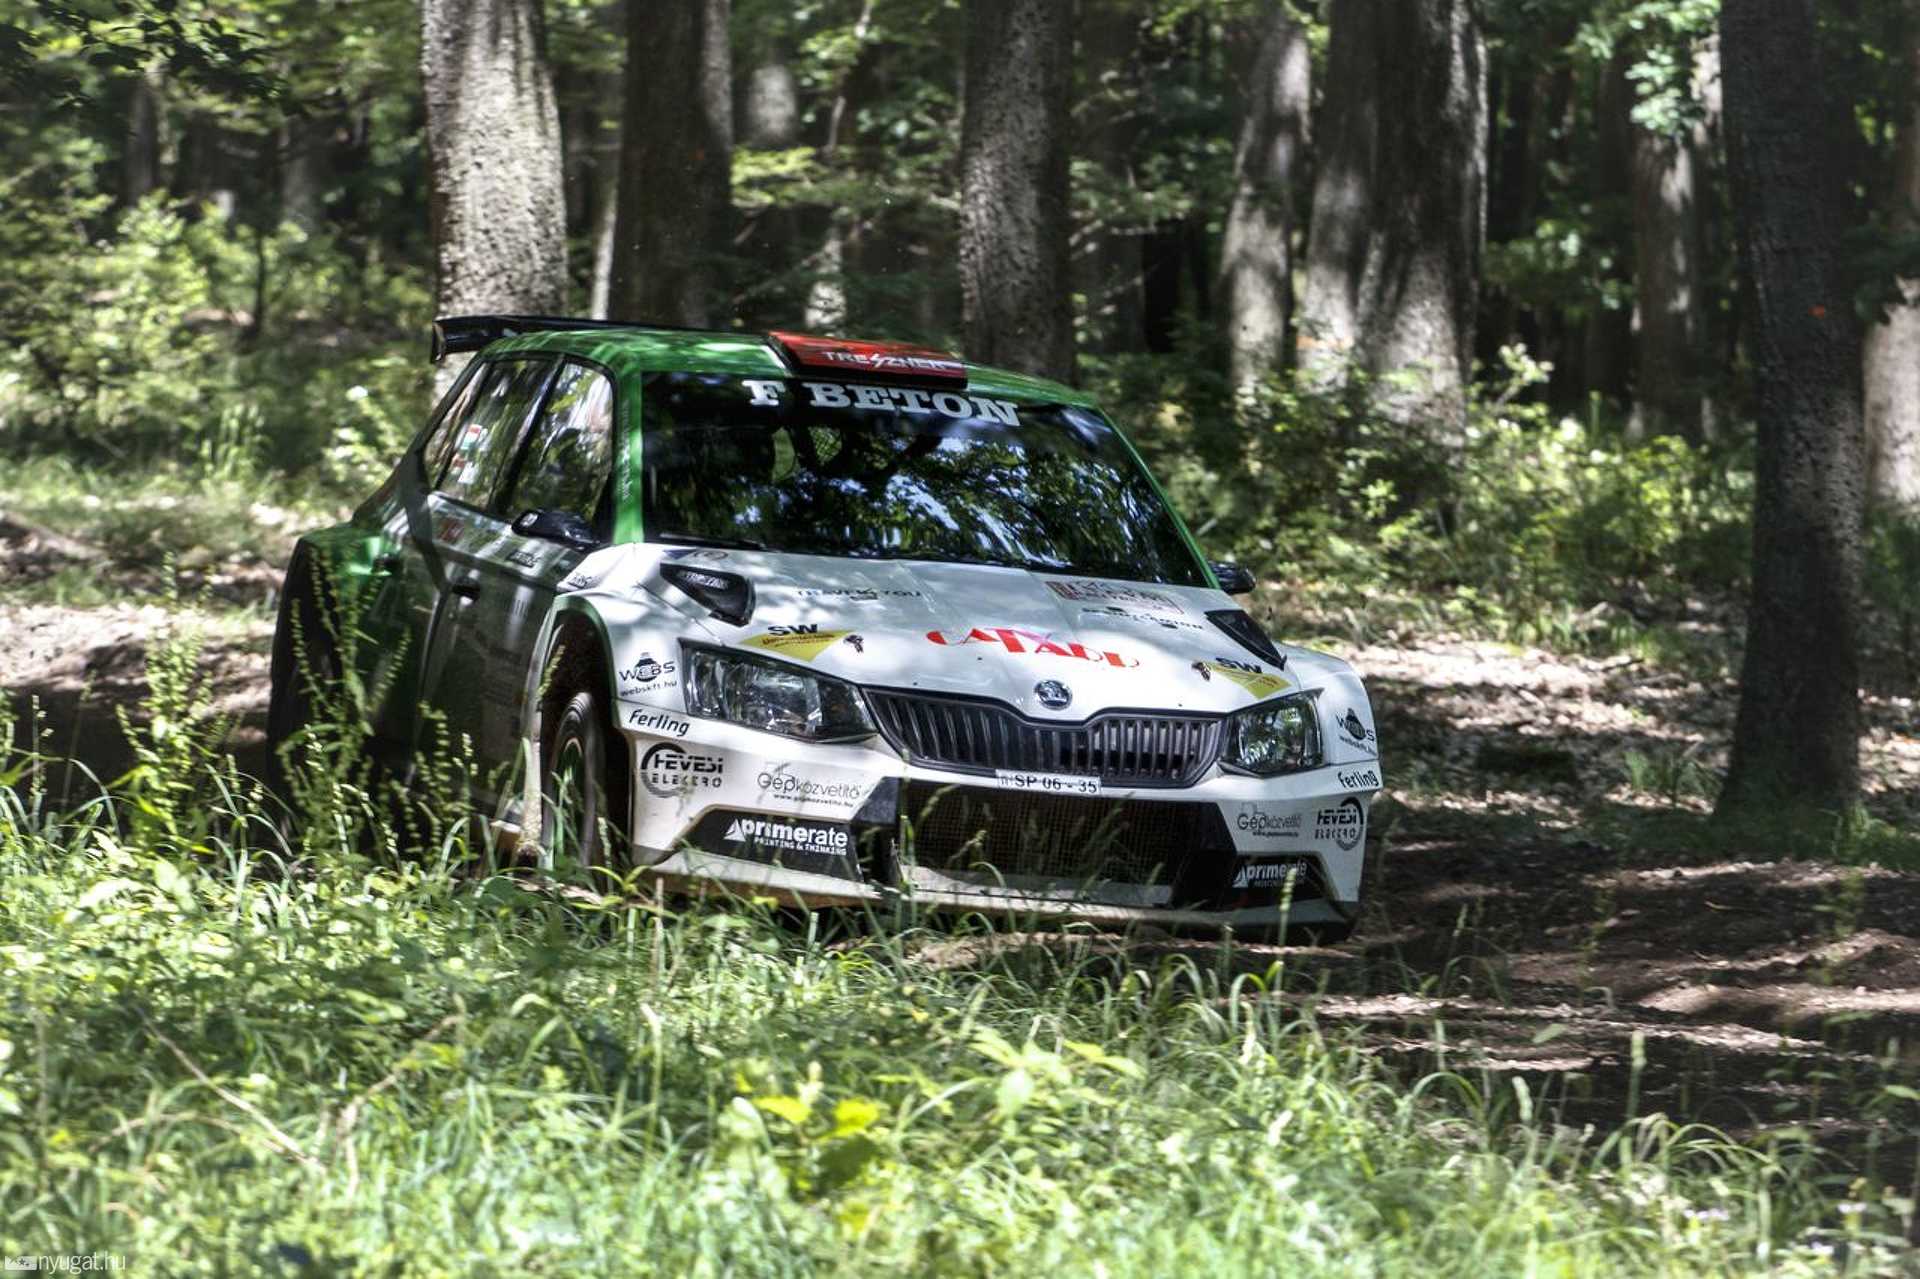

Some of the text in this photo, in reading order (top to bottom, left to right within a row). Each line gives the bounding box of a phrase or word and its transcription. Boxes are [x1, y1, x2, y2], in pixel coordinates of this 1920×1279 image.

[742, 379, 1021, 427] F BETON
[767, 623, 818, 636] SW
[628, 708, 690, 737] Ferling
[741, 818, 848, 848] primerate
